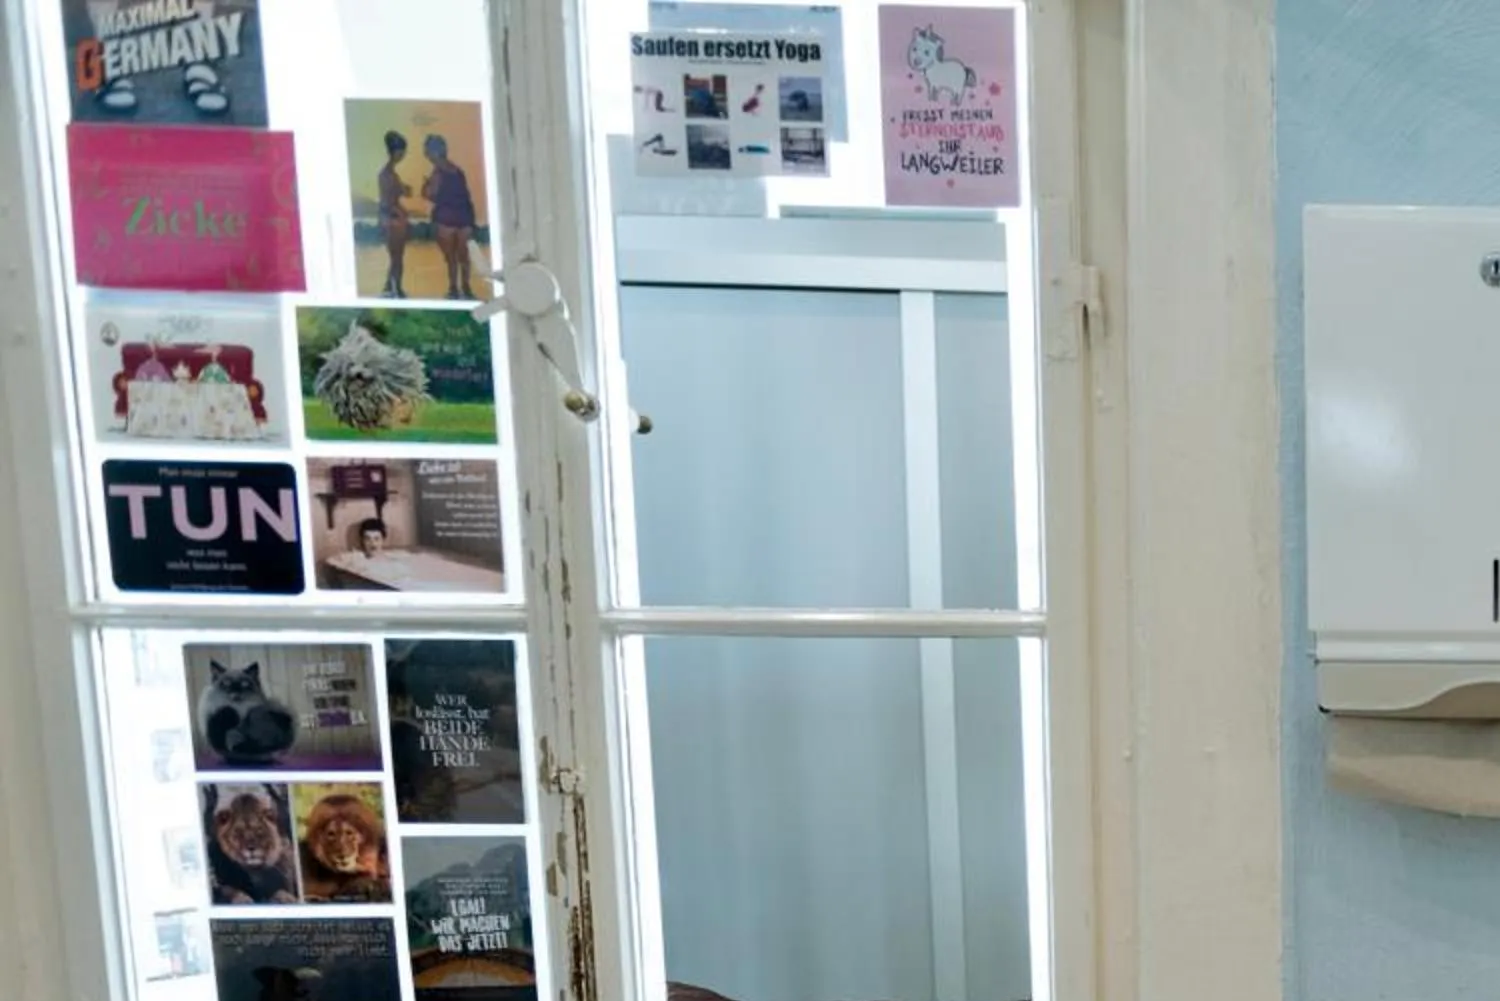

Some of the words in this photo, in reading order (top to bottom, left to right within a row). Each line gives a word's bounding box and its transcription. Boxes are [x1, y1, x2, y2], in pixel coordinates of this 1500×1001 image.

[100, 0, 195, 34] MAXIMAL
[76, 12, 243, 91] GERMANY
[631, 35, 699, 57] Saufen
[703, 38, 771, 59] ersetzt
[774, 39, 821, 62] Yoga
[950, 109, 993, 121] MEINEN
[901, 151, 1004, 175] LANGWEILER
[122, 196, 247, 237] Zicke
[108, 484, 298, 542] TUN
[435, 693, 467, 706] WER
[424, 720, 484, 735] BEIDE
